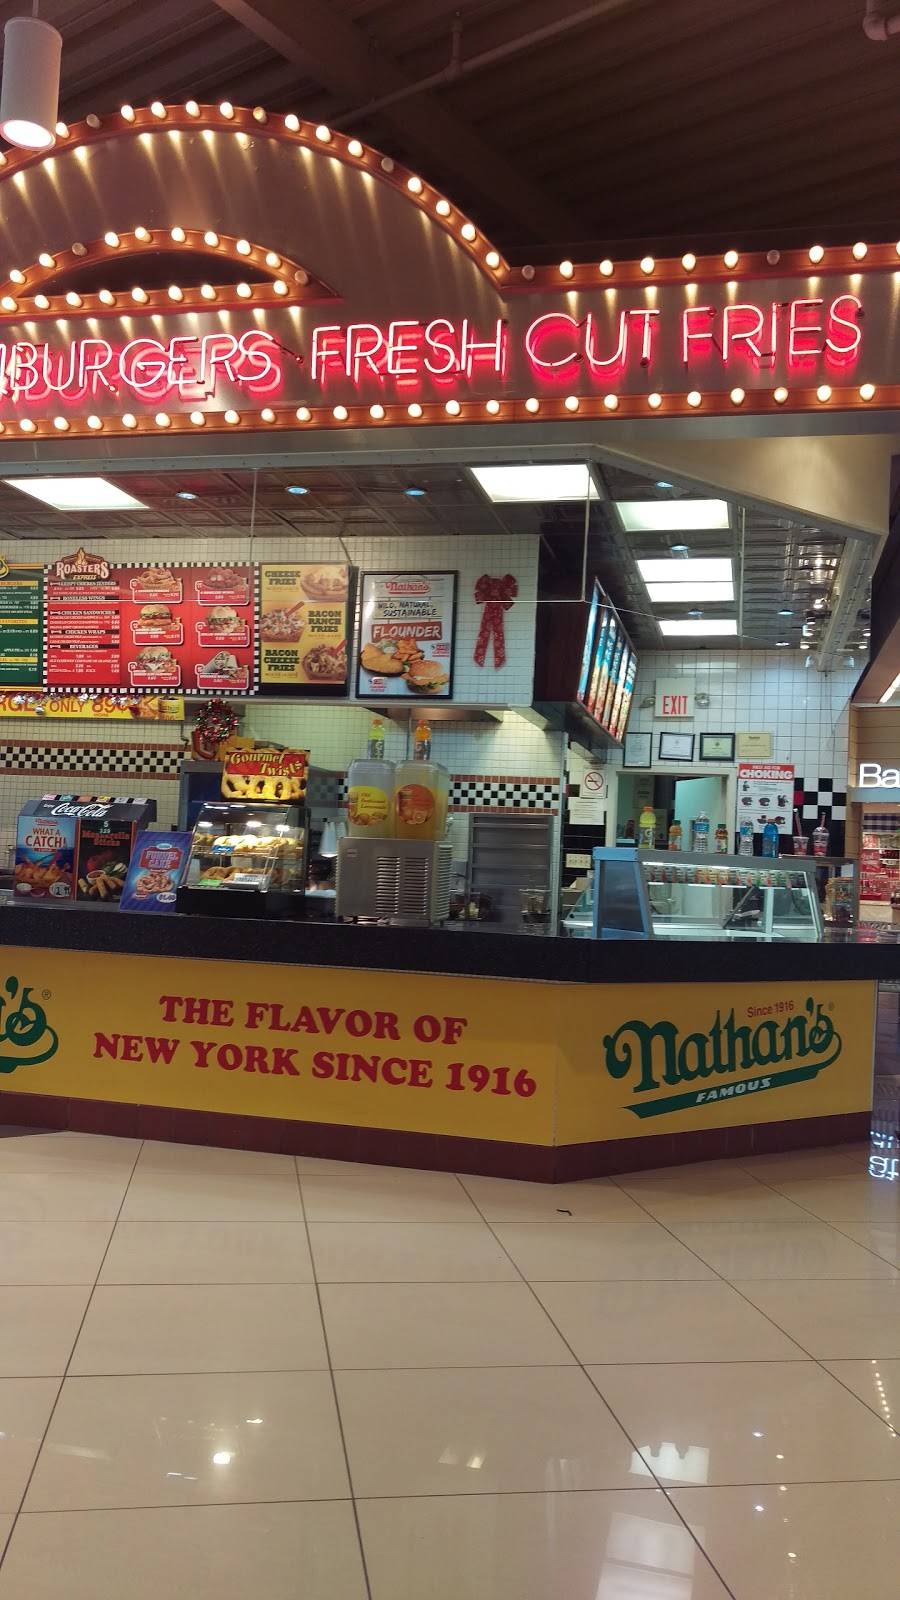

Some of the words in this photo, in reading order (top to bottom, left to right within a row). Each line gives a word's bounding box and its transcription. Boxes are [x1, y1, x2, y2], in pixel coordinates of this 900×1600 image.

[311, 317, 504, 381] FRESH
[525, 309, 661, 368] CUT
[682, 294, 863, 363] FRIES
[56, 562, 109, 579] ROASTERS
[383, 608, 437, 617] SUSTAINABLE
[372, 625, 441, 639] FLOUNDER
[265, 649, 298, 657] BACON
[49, 700, 86, 713] ONLY
[662, 695, 689, 715] EXIT
[230, 752, 285, 765] Gourmet
[260, 761, 303, 776] Twists
[740, 769, 793, 780] CHOKING
[859, 762, 900, 789] Ba
[32, 827, 54, 836] WHAT
[25, 835, 66, 849] CATCH!
[746, 1005, 774, 1019] Since
[774, 999, 795, 1014] 1916
[159, 995, 235, 1028] THE
[246, 1002, 402, 1041] FLAVOR
[412, 1014, 468, 1045] OF
[602, 996, 835, 1094] Nathan's
[93, 1032, 181, 1065] NEW
[190, 1040, 301, 1077] YORK
[311, 1051, 434, 1089] SINCE
[446, 1062, 538, 1098] 1916
[695, 1077, 772, 1104] FAMOUS
